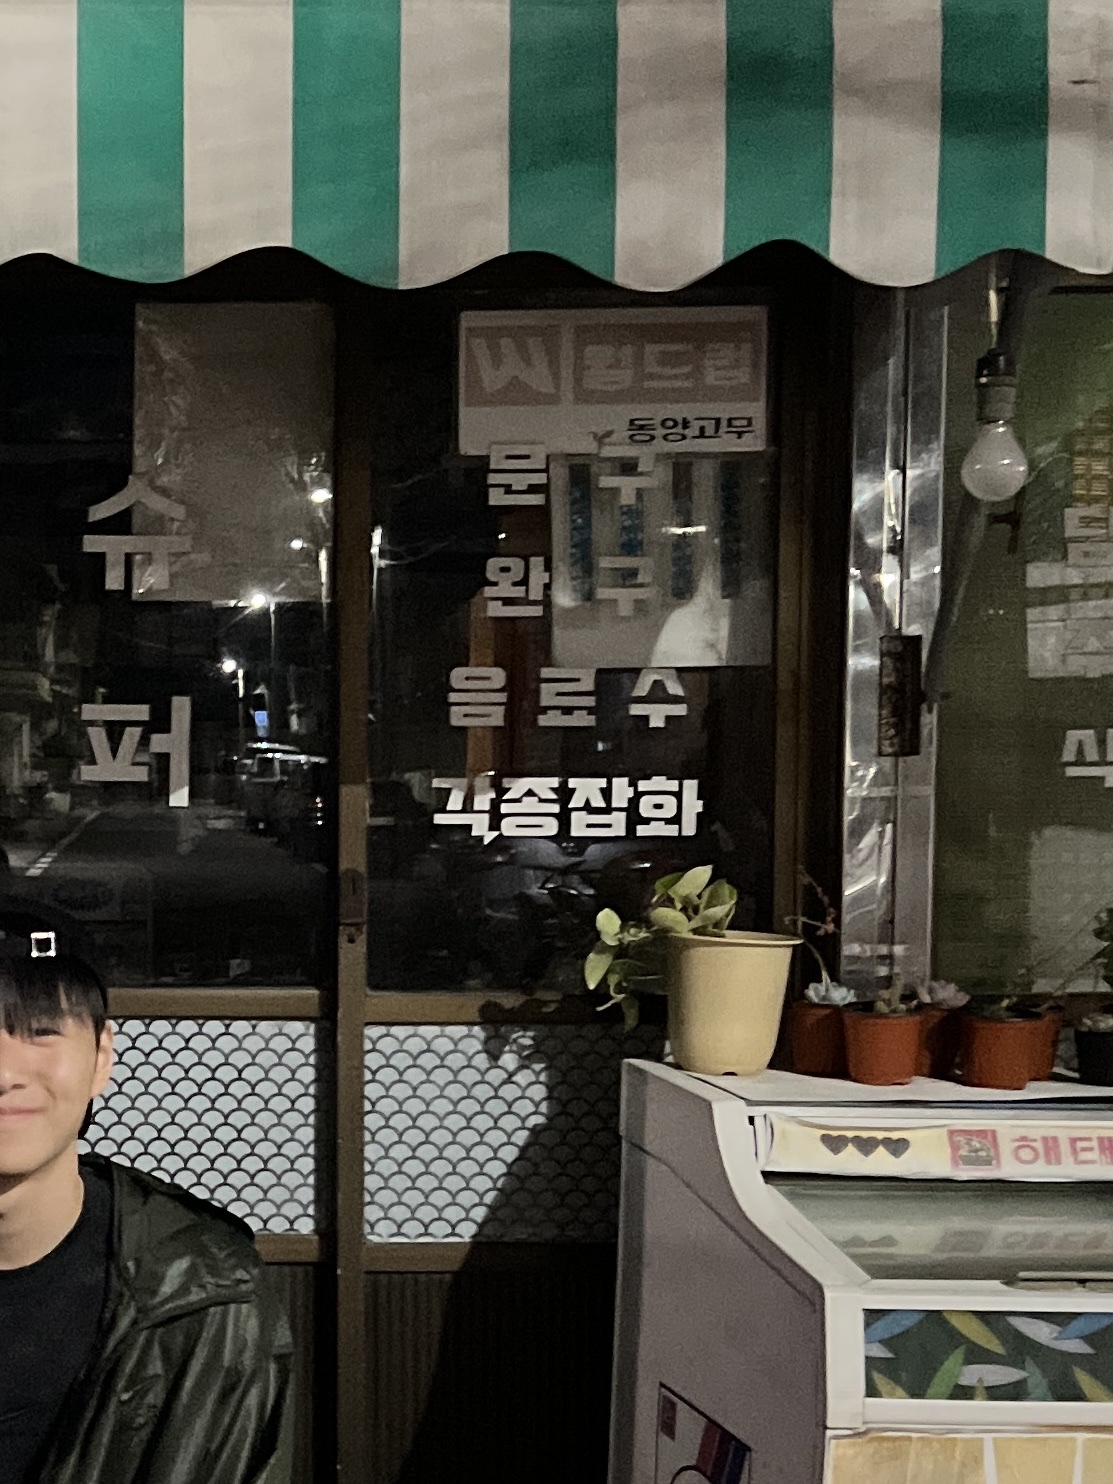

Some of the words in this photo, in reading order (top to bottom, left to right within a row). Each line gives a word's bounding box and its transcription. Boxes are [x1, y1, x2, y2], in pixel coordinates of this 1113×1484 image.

[626, 415, 756, 444] 동양고무
[487, 441, 658, 506] 문구
[484, 555, 657, 618] 완구
[80, 475, 192, 807] 슈퍼
[447, 665, 688, 728] 음료수
[431, 774, 704, 844] 각종잡화
[1010, 1135, 1113, 1166] 해태
